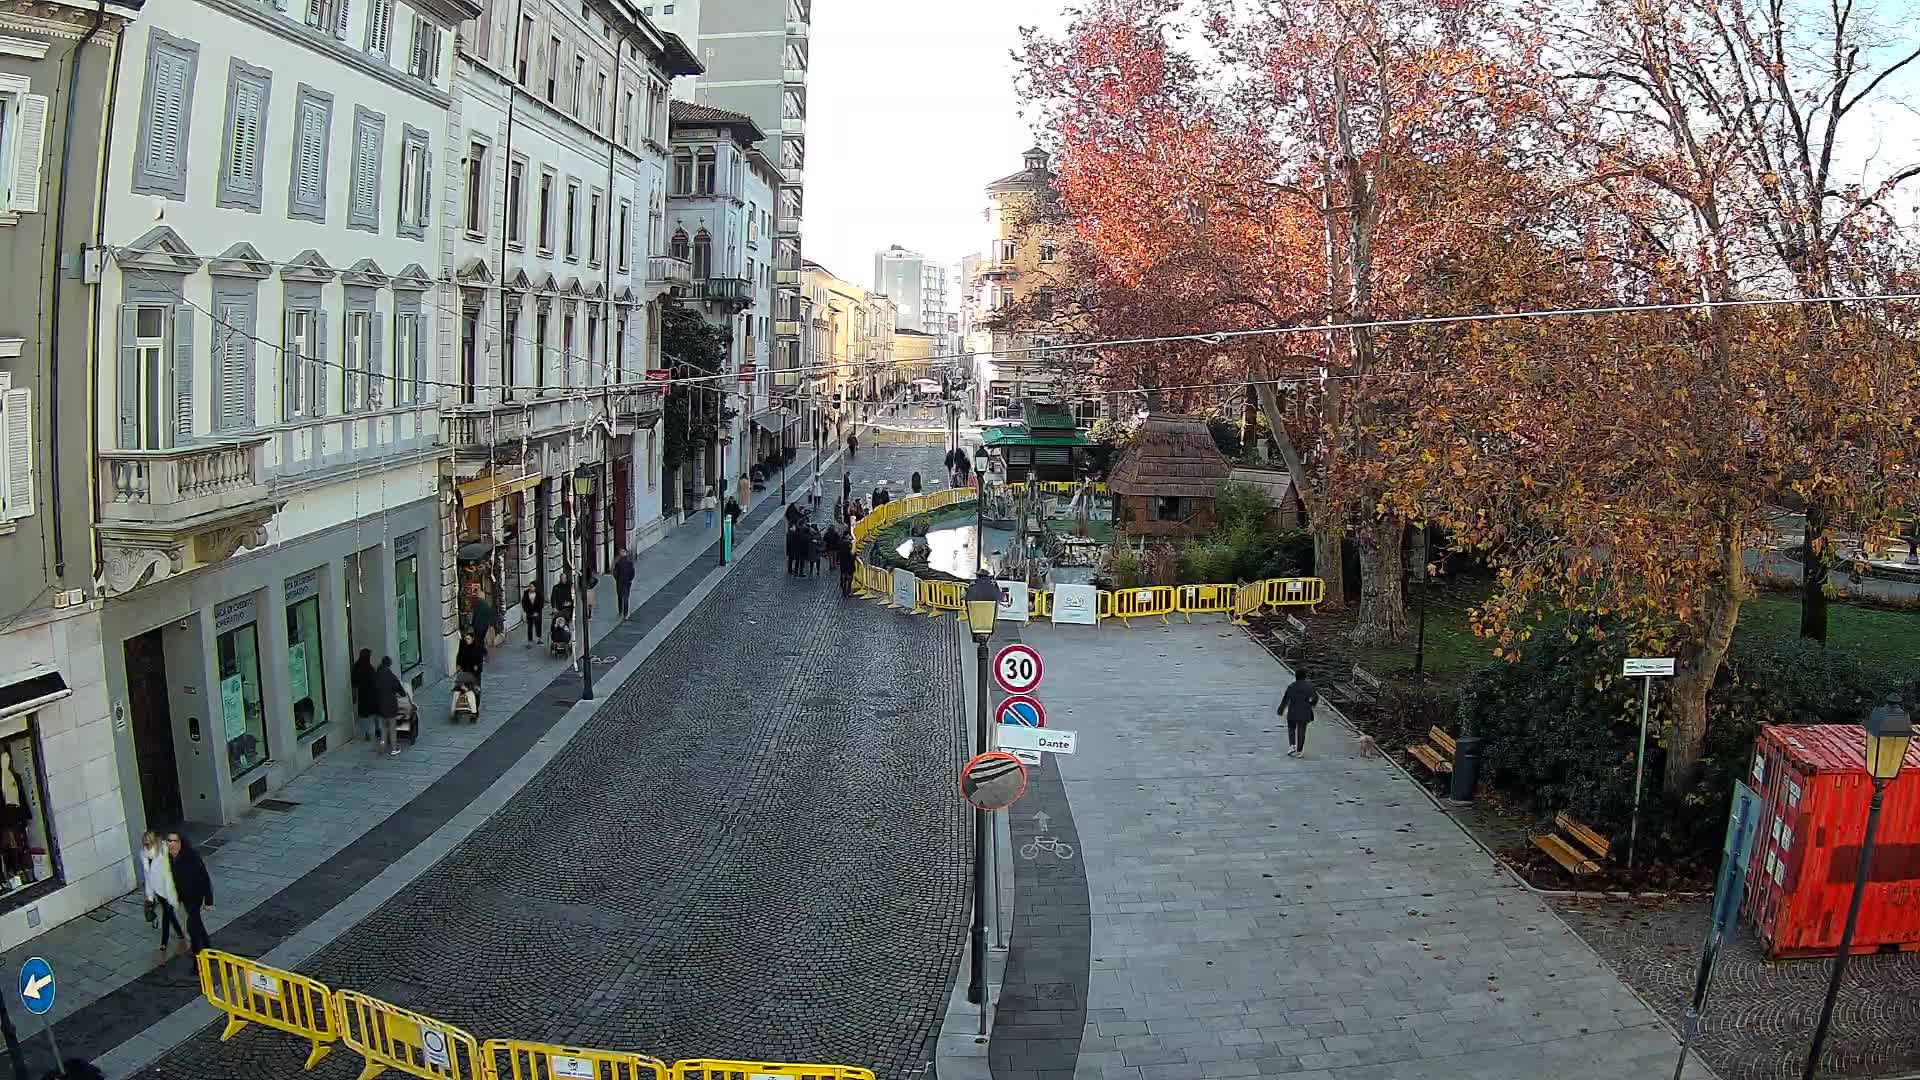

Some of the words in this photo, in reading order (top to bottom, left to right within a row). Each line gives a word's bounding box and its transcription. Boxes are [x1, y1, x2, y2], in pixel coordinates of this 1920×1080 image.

[216, 612, 245, 629] OPERATIVO
[1006, 658, 1033, 680] 30
[1039, 737, 1070, 749] Dante
